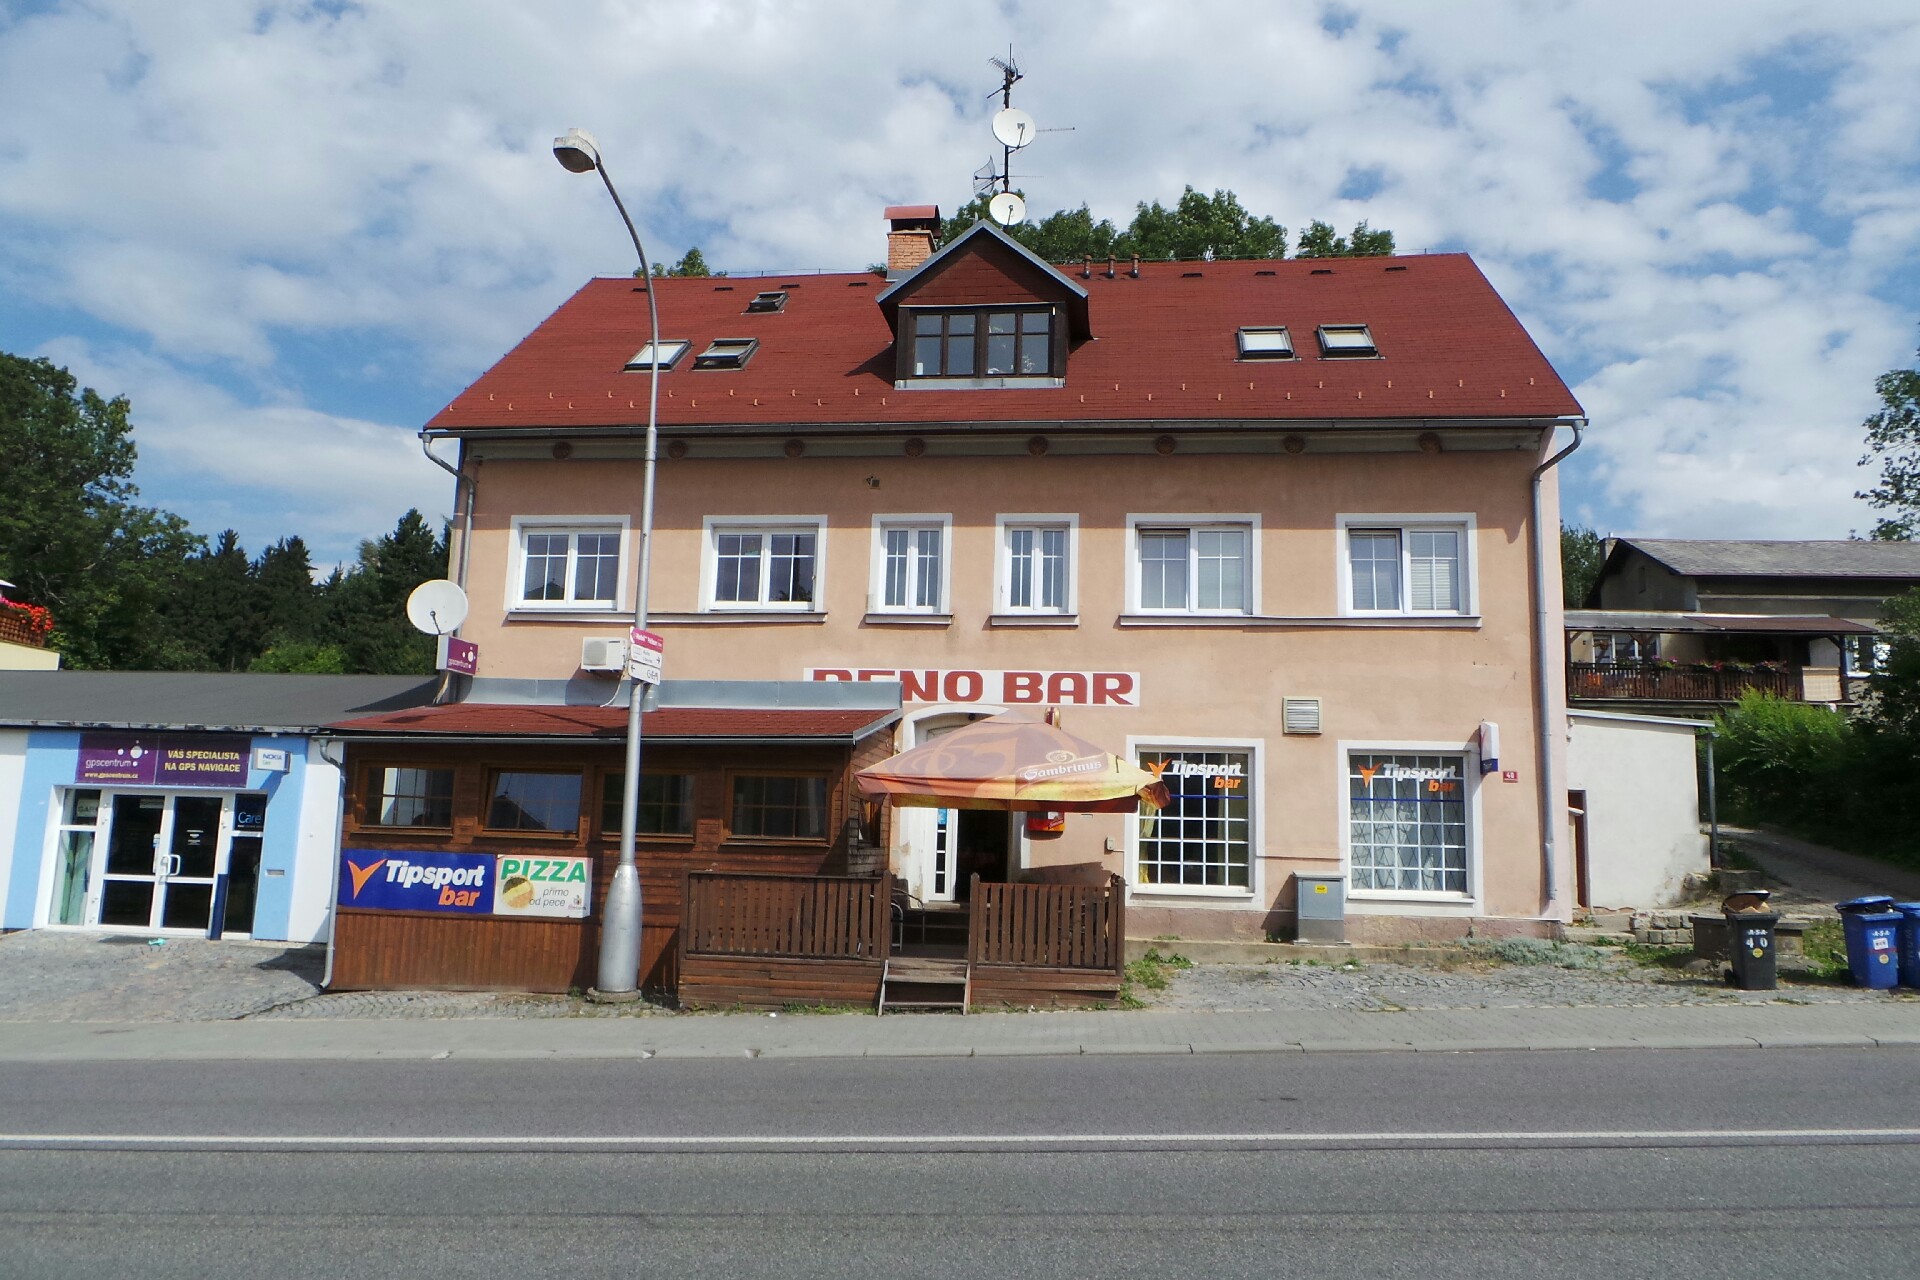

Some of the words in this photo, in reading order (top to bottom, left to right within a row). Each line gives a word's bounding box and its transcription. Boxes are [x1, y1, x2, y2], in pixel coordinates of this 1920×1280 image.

[1003, 671, 1133, 705] BAR
[185, 750, 240, 760] SPECIALISTA
[85, 759, 131, 769] gpscentrum
[164, 762, 176, 771] NA
[178, 763, 196, 771] GPS
[198, 763, 241, 773] NAVIGACE
[1020, 761, 1102, 780] Gambrinus
[1171, 760, 1242, 778] Tipsport
[1383, 763, 1456, 781] Tipsport
[1214, 776, 1241, 788] bar
[1428, 780, 1455, 792] bar
[238, 812, 262, 824] Care
[386, 860, 485, 889] Tipsport
[501, 859, 586, 883] PIZZA
[438, 886, 480, 907] bar
[529, 897, 541, 906] od
[542, 899, 566, 908] pece
